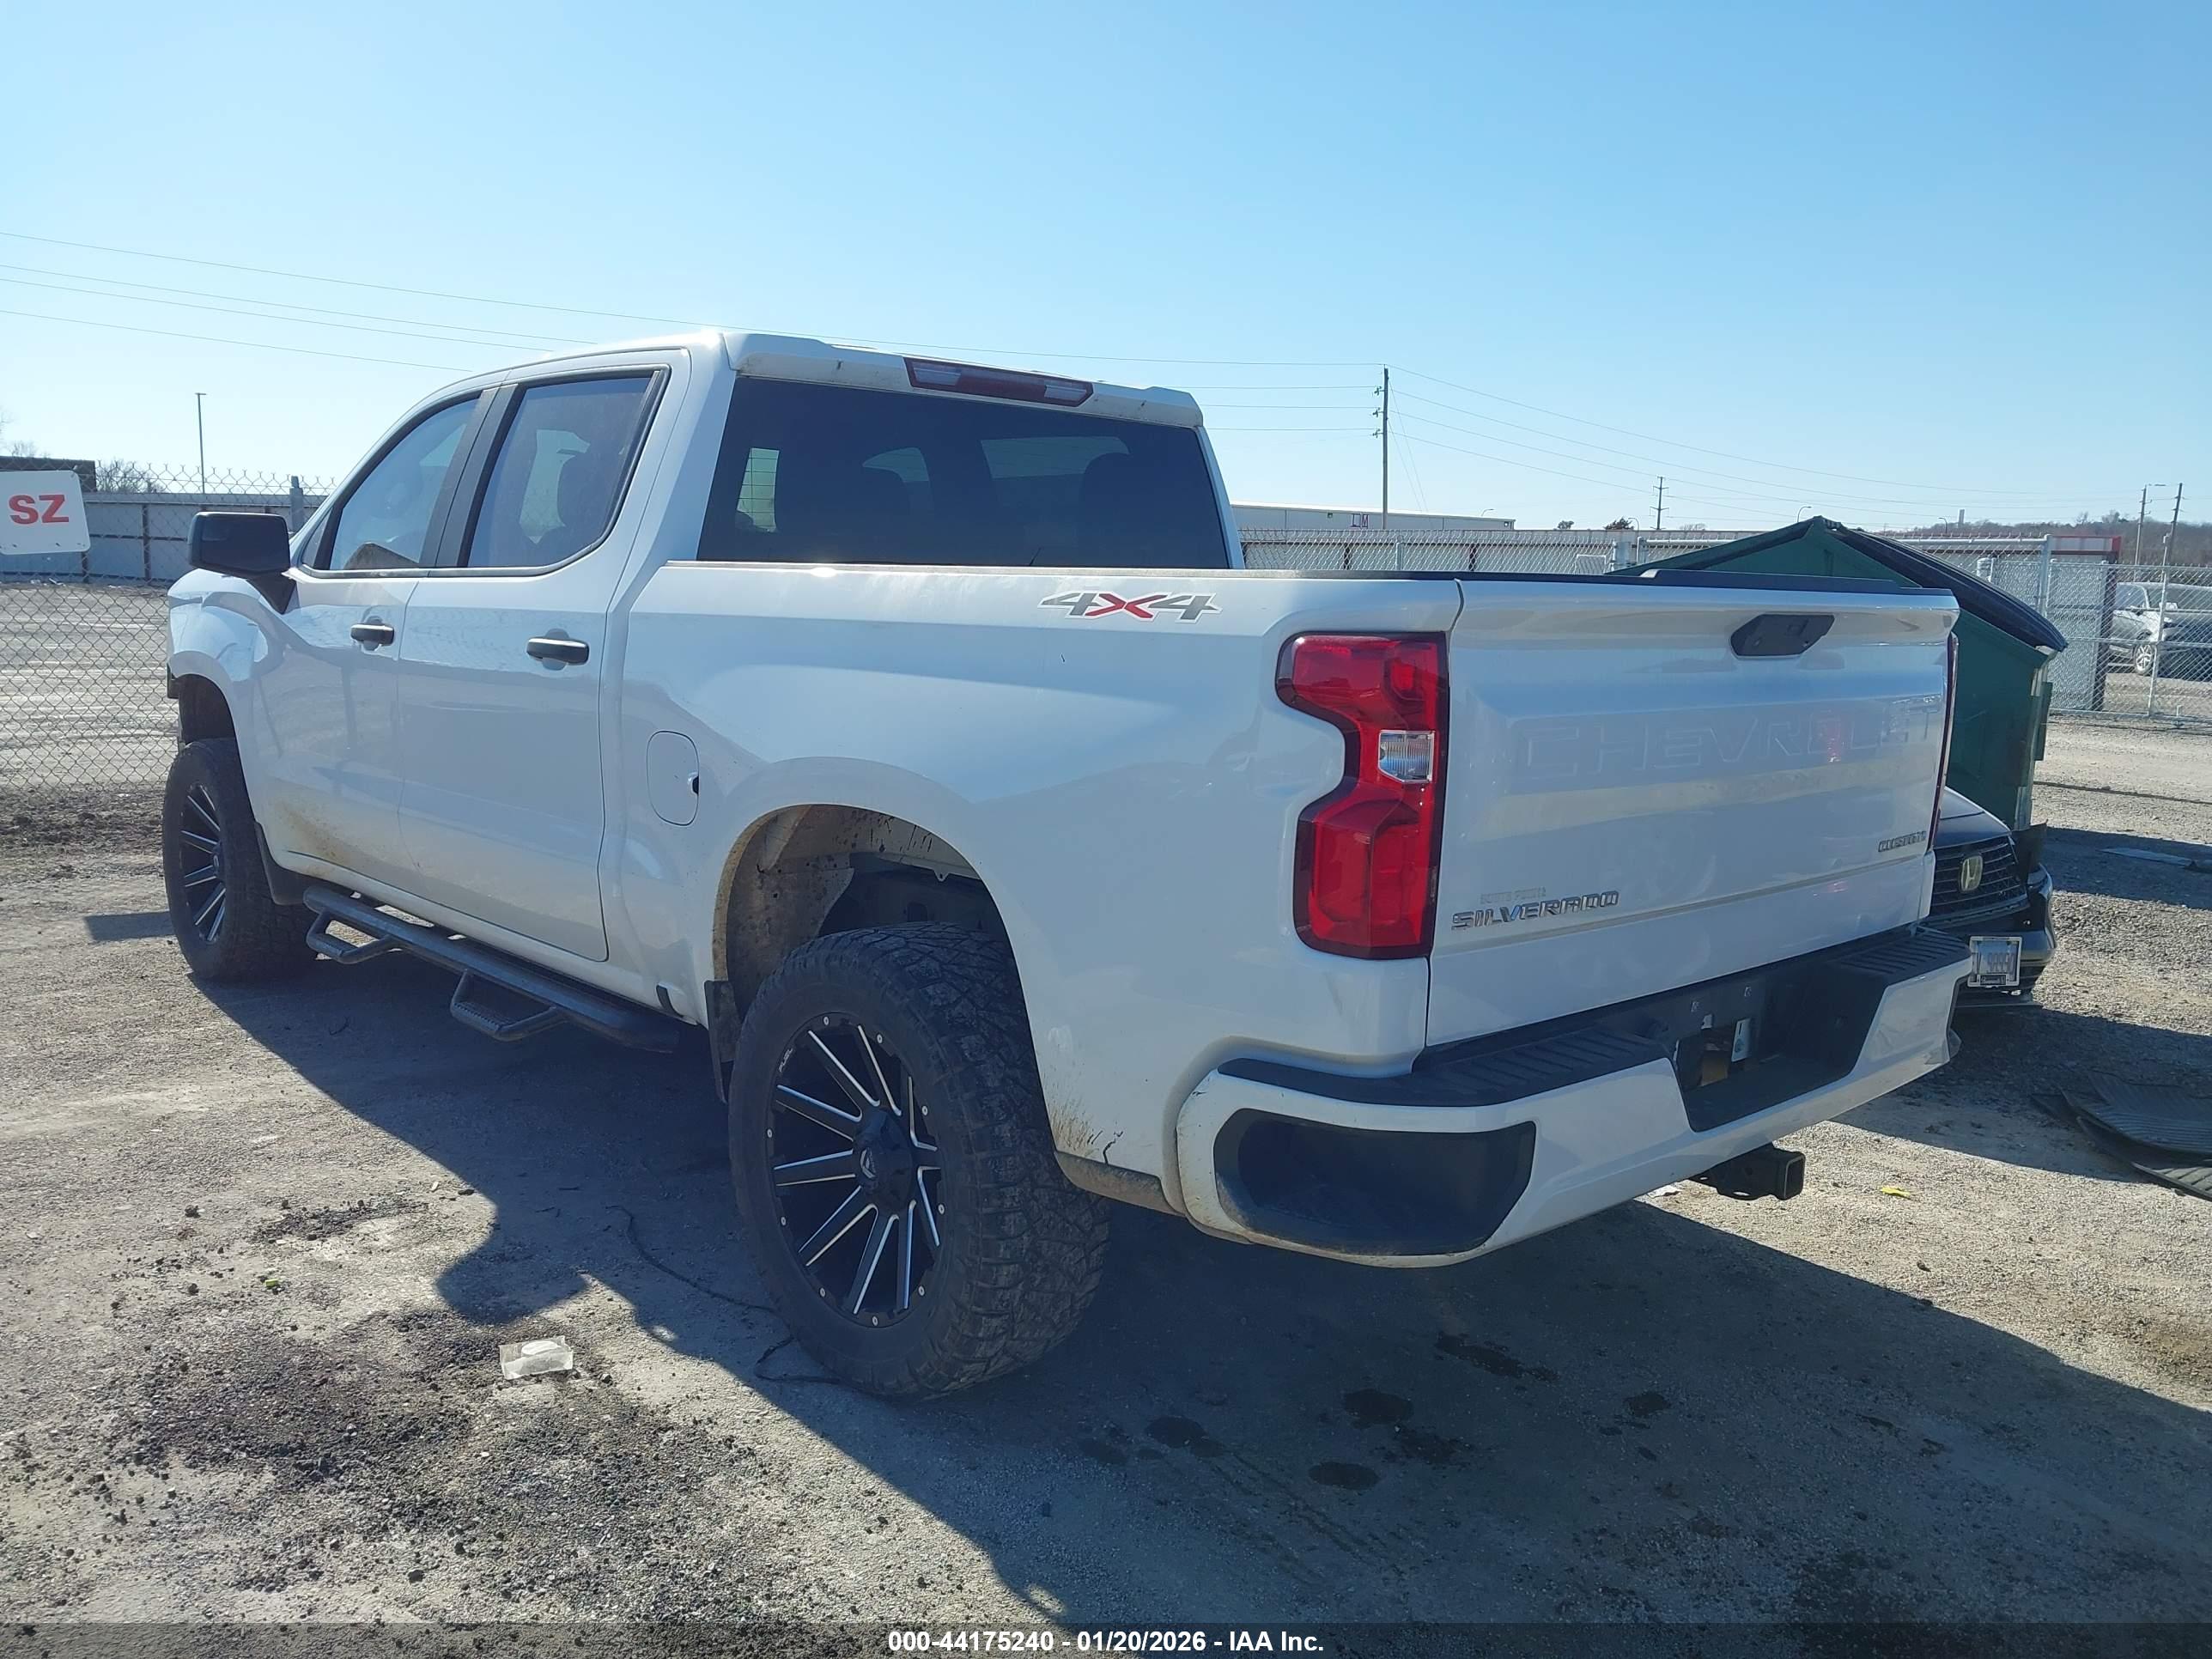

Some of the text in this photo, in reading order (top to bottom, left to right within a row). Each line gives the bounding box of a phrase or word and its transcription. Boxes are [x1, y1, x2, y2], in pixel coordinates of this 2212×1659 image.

[9, 494, 70, 525] SZ
[1527, 699, 1939, 780] CHEVROLET
[1451, 890, 1620, 931] SILVERADO
